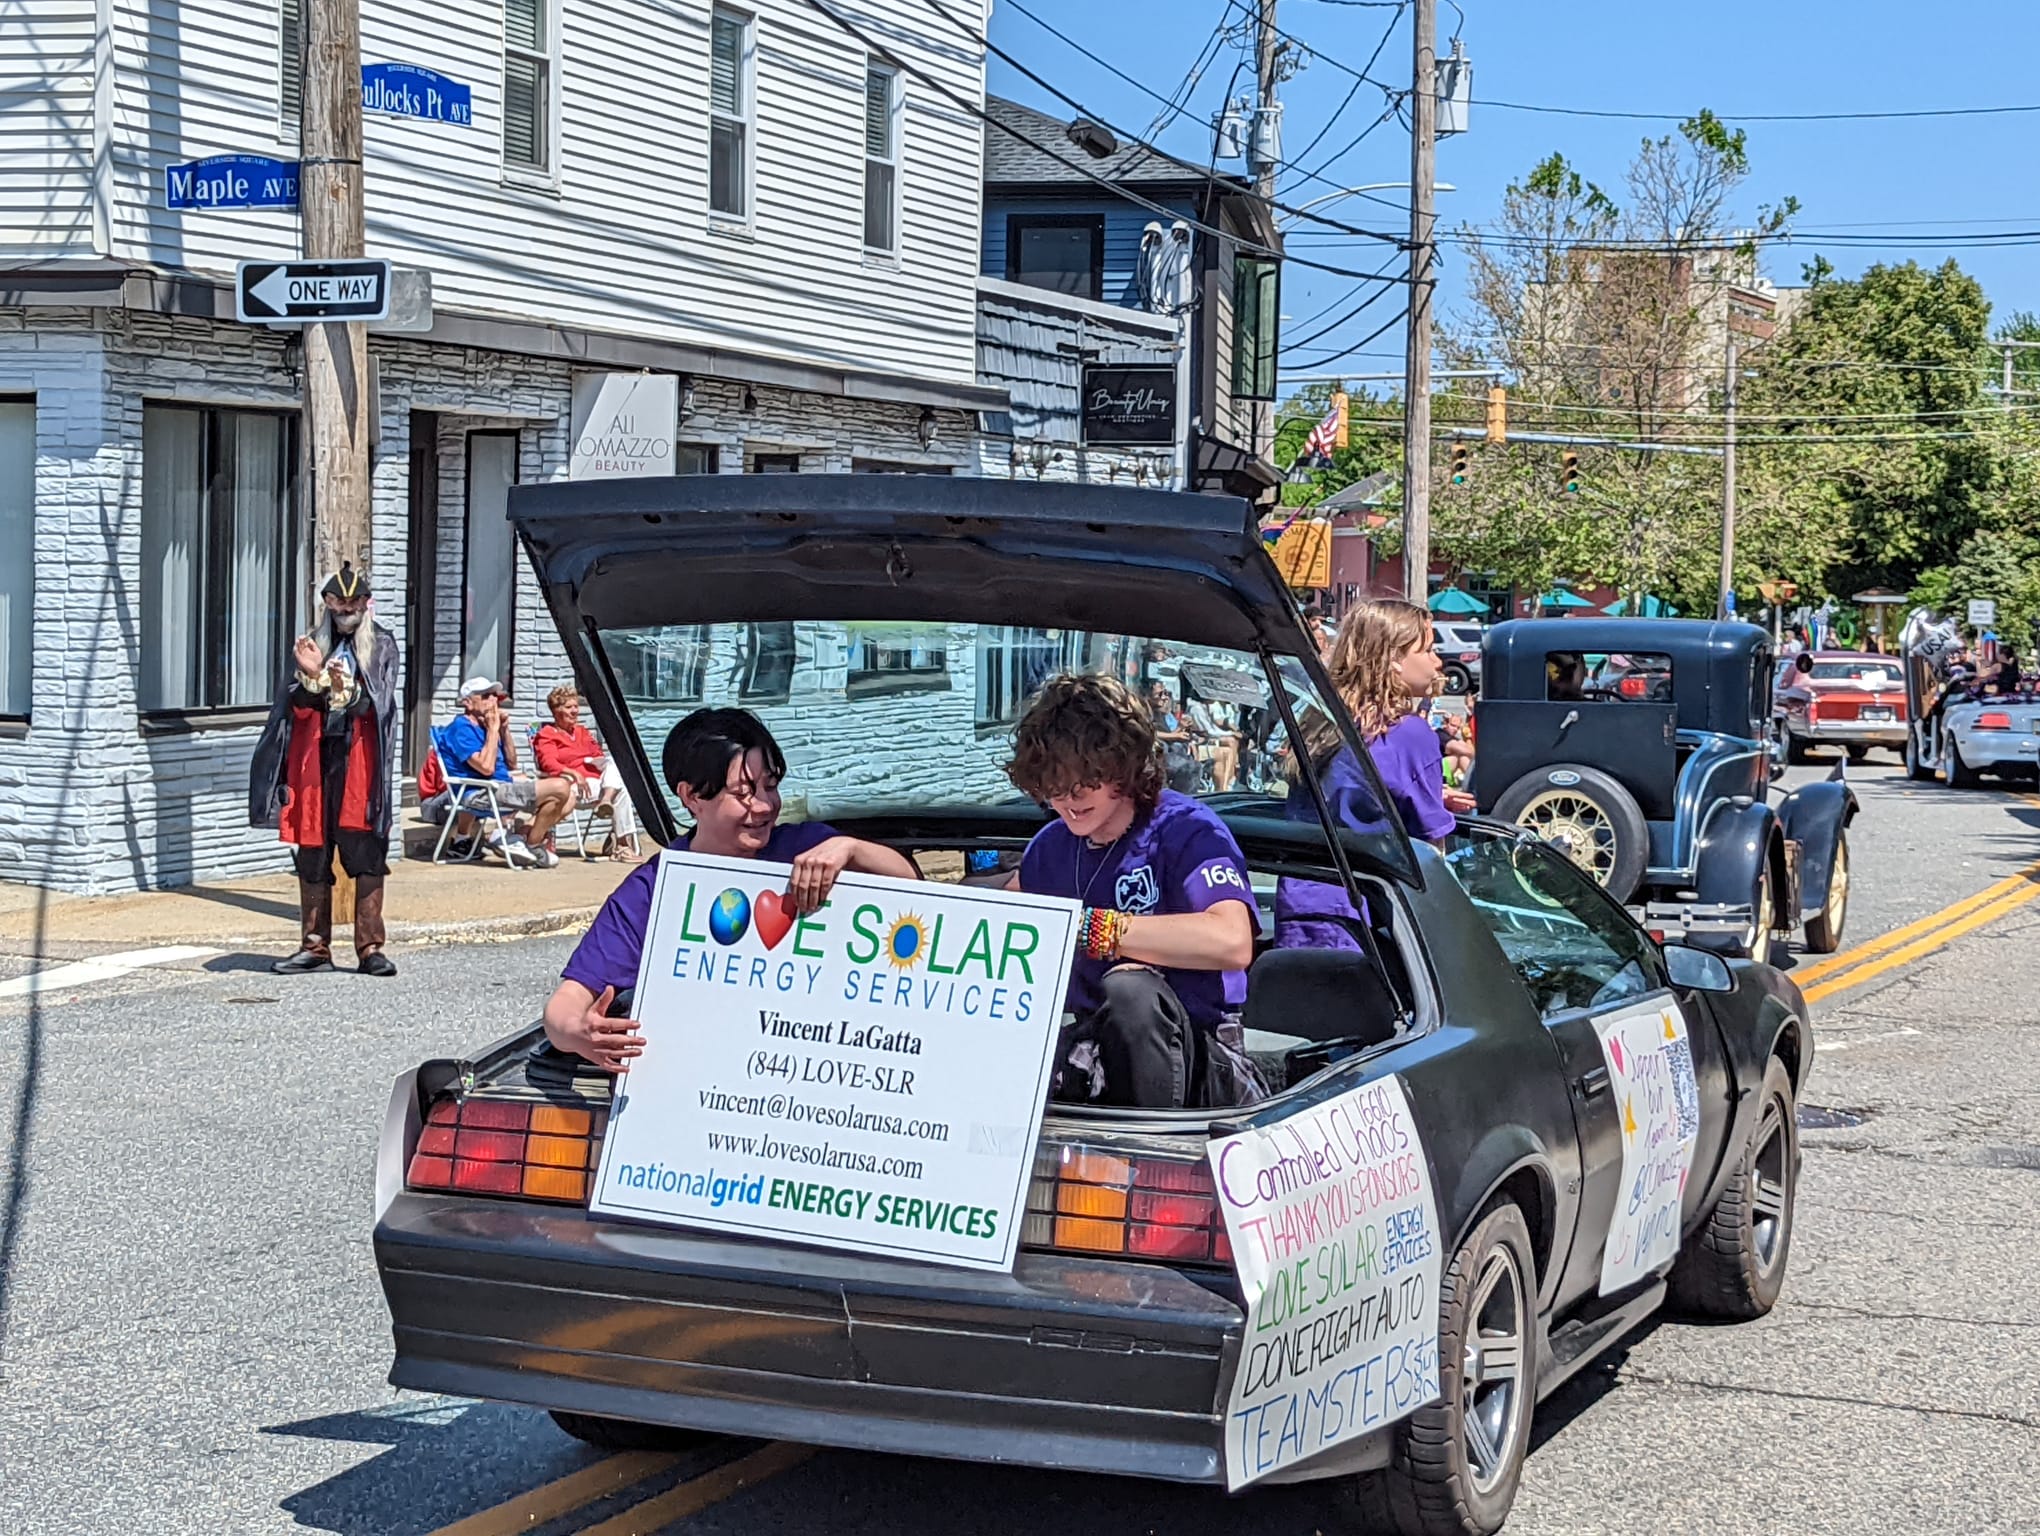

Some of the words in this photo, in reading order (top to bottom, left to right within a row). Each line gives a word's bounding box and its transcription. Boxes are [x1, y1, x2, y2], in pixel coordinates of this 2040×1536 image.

[361, 78, 421, 114] ullocks
[426, 87, 443, 119] Pt
[450, 102, 470, 123] AVE
[170, 169, 249, 206] Maple
[261, 177, 297, 198] AVE
[289, 281, 331, 301] ONE
[338, 278, 373, 300] WAY
[609, 415, 635, 435] ALI
[595, 459, 645, 472] BEAUTY
[672, 947, 822, 995] ENERGY
[844, 969, 1033, 1022] SERVICES
[759, 1010, 834, 1044] Vincent
[837, 1021, 923, 1056] LaGatta
[747, 1050, 798, 1084] (844)
[801, 1057, 915, 1096] LOVE-SLR
[698, 1085, 950, 1142] vincent@lovesolarusa.com
[708, 1132, 924, 1180] www.lovesolarusa.com
[1218, 1116, 1343, 1209] Controlled
[617, 1161, 765, 1208] nationalgrid
[768, 1178, 873, 1220] ENERGY
[874, 1193, 999, 1240] SERVICES
[1238, 1192, 1325, 1263] THANK
[1319, 1179, 1351, 1238] YOU
[1349, 1152, 1421, 1216] SPONSORS
[1385, 1202, 1424, 1243] ENERGY
[1382, 1230, 1432, 1276] SERVICES
[1256, 1257, 1312, 1333] LOVE
[1316, 1224, 1380, 1305] SOLAR
[1243, 1324, 1312, 1399] DONE
[1309, 1295, 1377, 1372] RIGHT
[1372, 1273, 1425, 1341] AUTO
[1231, 1339, 1415, 1479] TEAMSTERS
